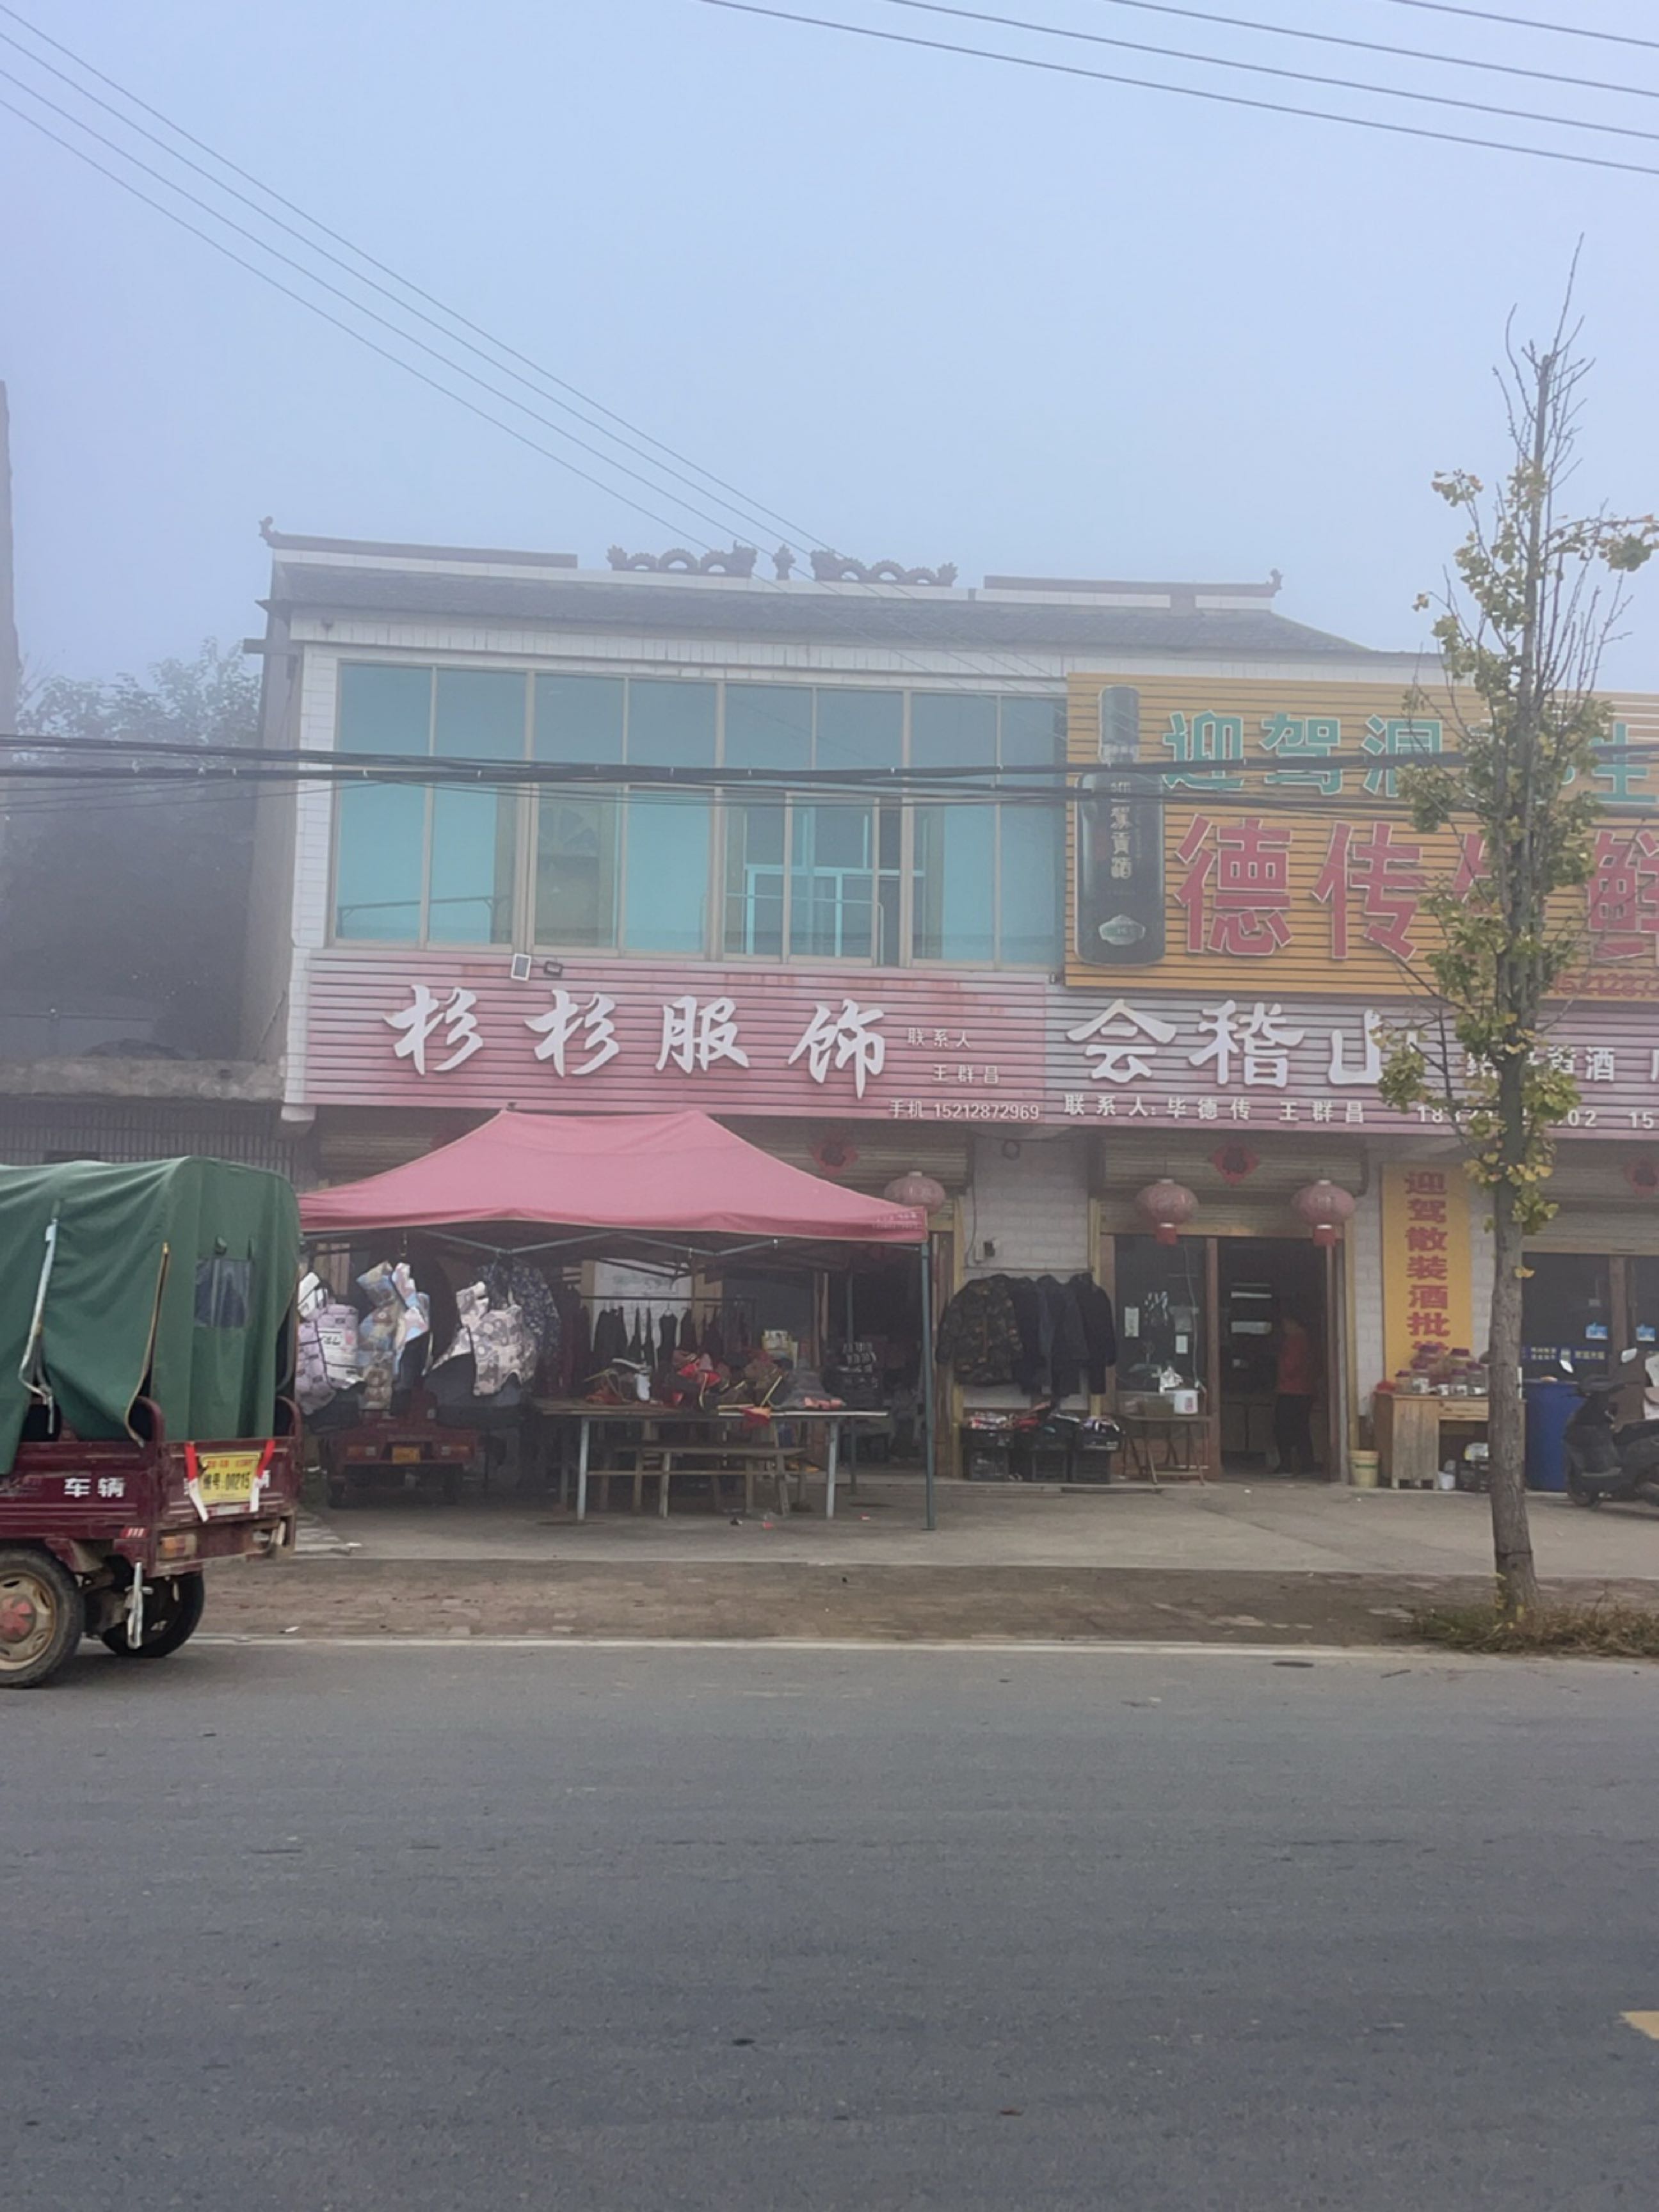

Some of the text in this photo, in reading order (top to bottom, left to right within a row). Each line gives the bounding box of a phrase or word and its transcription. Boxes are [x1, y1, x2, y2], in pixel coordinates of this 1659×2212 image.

[1174, 813, 1659, 962] 德传鲜
[383, 984, 886, 1100] 杉杉服饰
[907, 1027, 972, 1048] 联系人
[1067, 998, 1416, 1087] 会稽山
[933, 1064, 998, 1084] 王群昌
[888, 1100, 1039, 1120] 手机 15212872969
[1279, 1100, 1364, 1124] 王群昌
[1405, 1171, 1450, 1352] 迎驾散装酒批
[64, 1477, 125, 1498] 车辆
